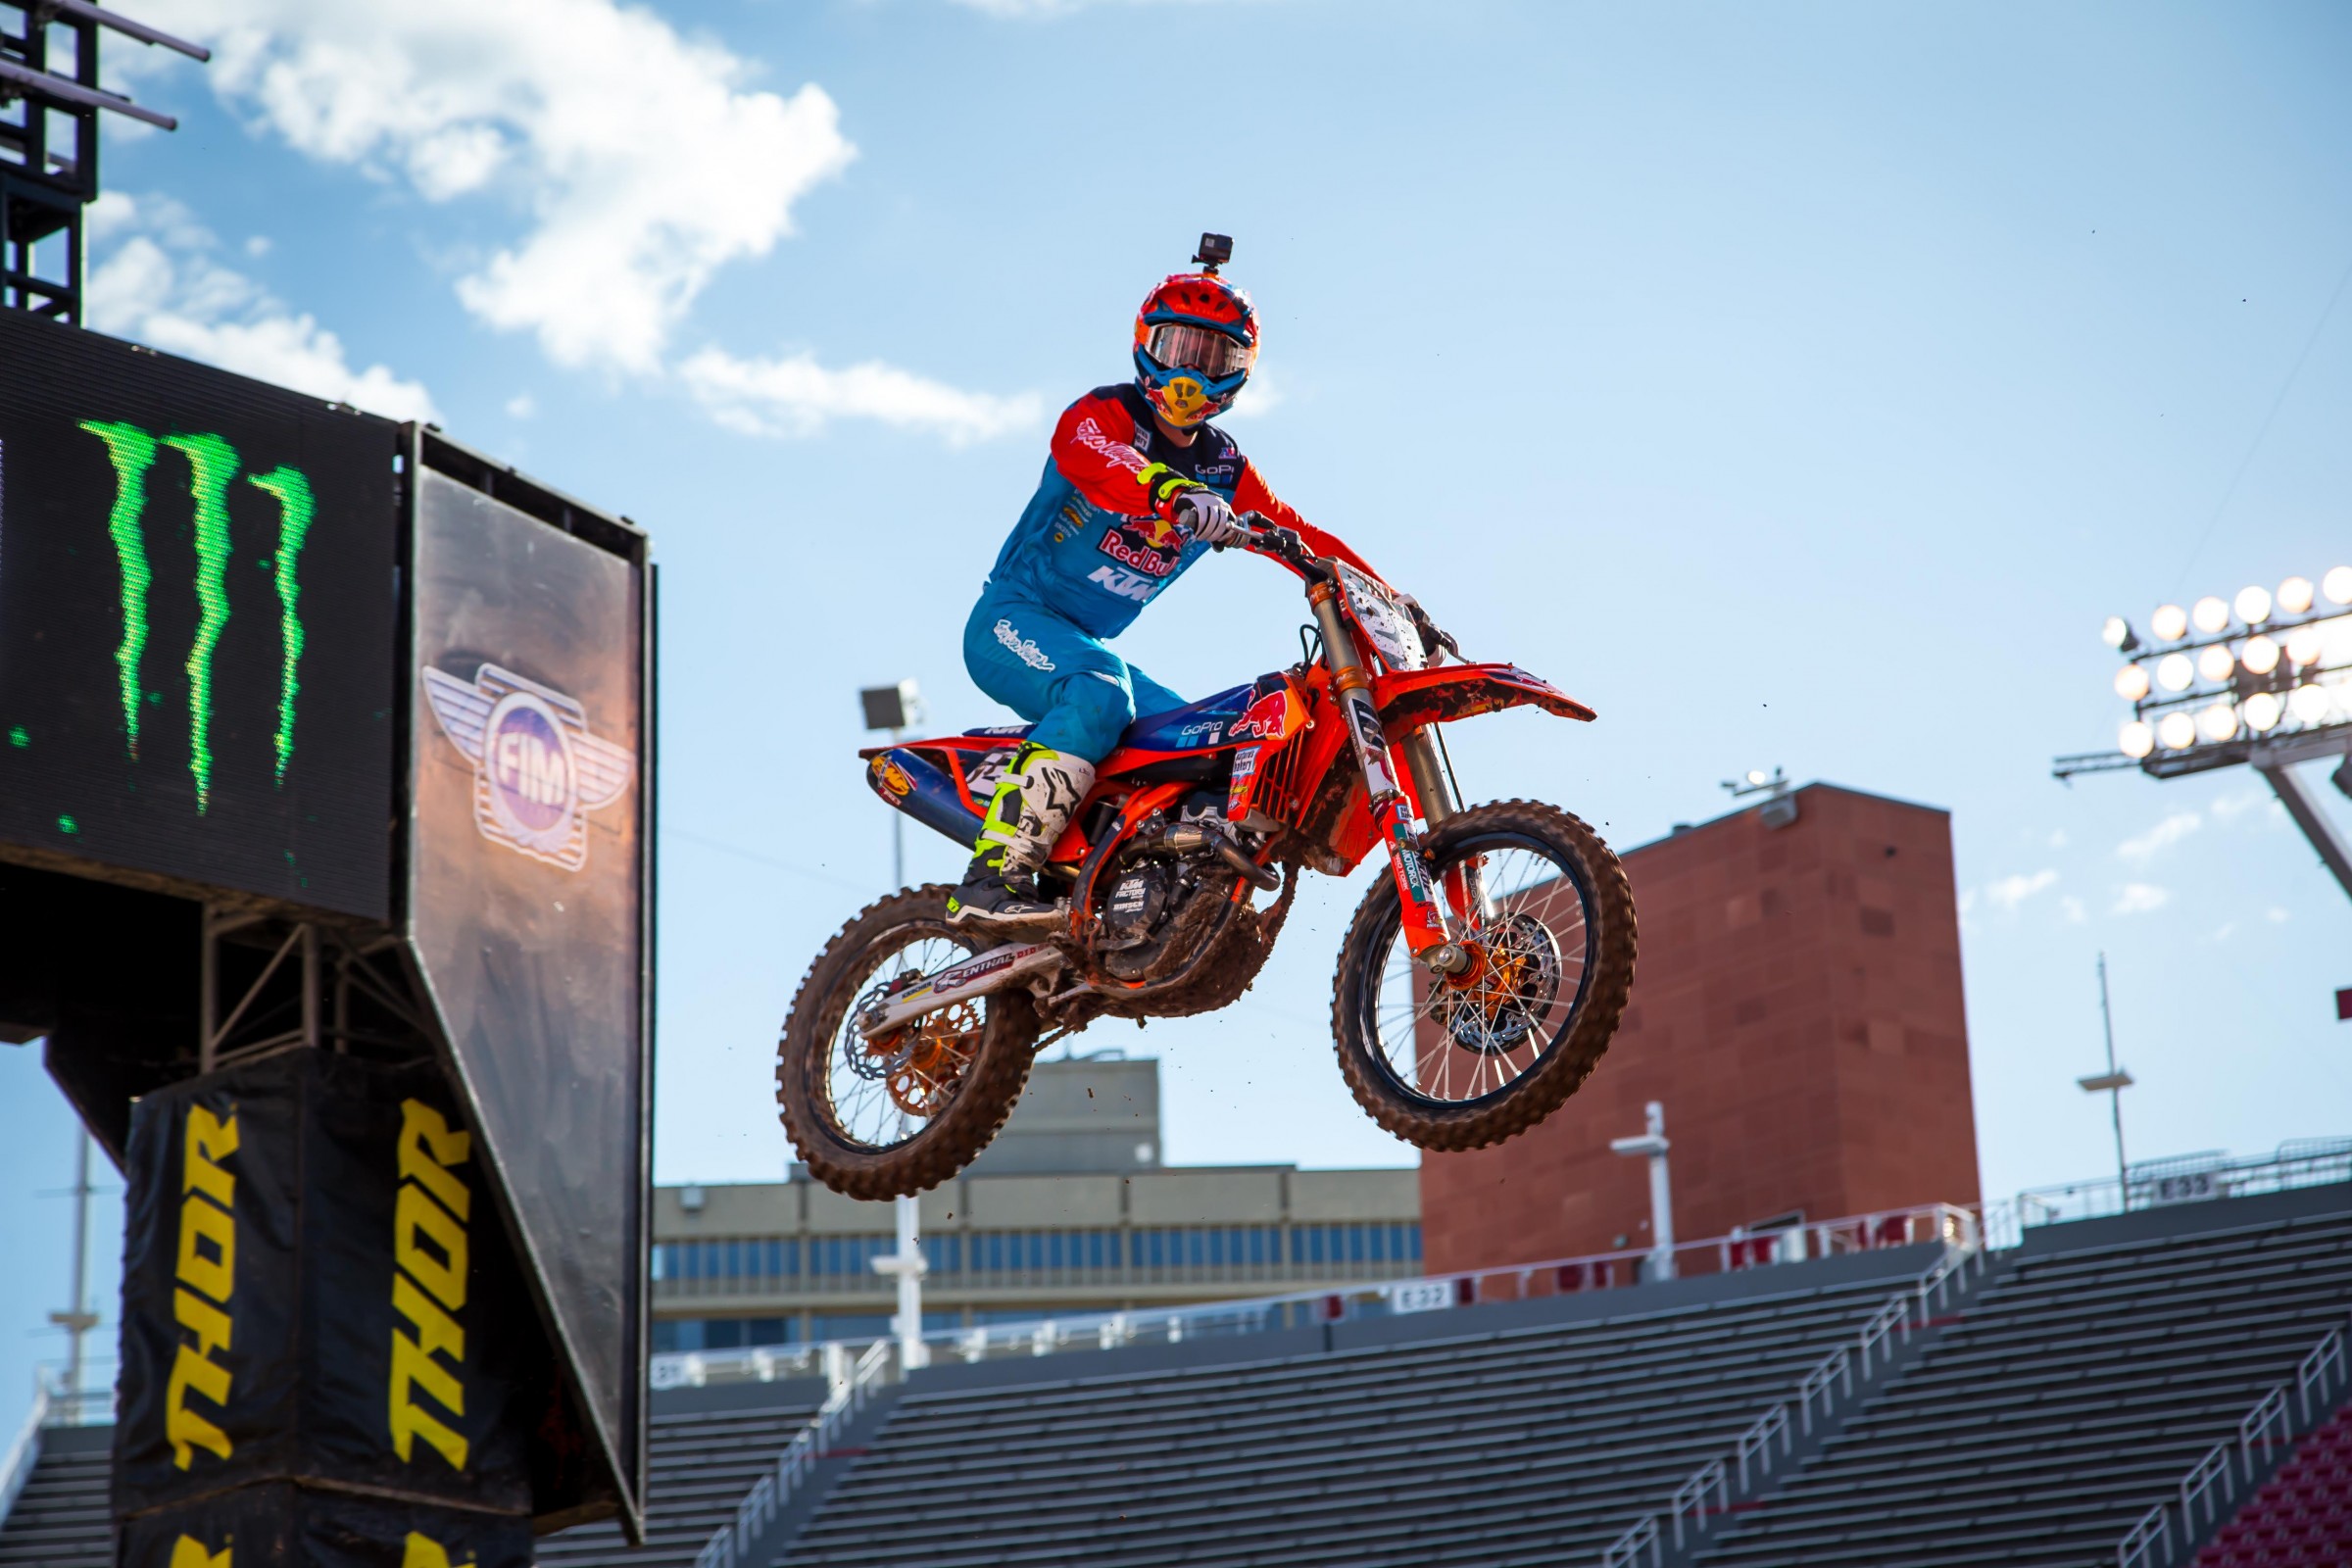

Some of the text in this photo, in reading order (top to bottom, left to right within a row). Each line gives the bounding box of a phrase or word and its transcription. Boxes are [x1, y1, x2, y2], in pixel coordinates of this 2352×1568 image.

[1099, 529, 1151, 569] Red
[1087, 565, 1157, 601] KTM
[1182, 721, 1223, 735] GoPro
[498, 732, 566, 806] FIM
[1401, 849, 1420, 888] MOTOREX
[2159, 1173, 2210, 1200] E33
[166, 1103, 239, 1471] THOR
[389, 1097, 470, 1471] THOR
[1401, 1284, 1444, 1307] E32
